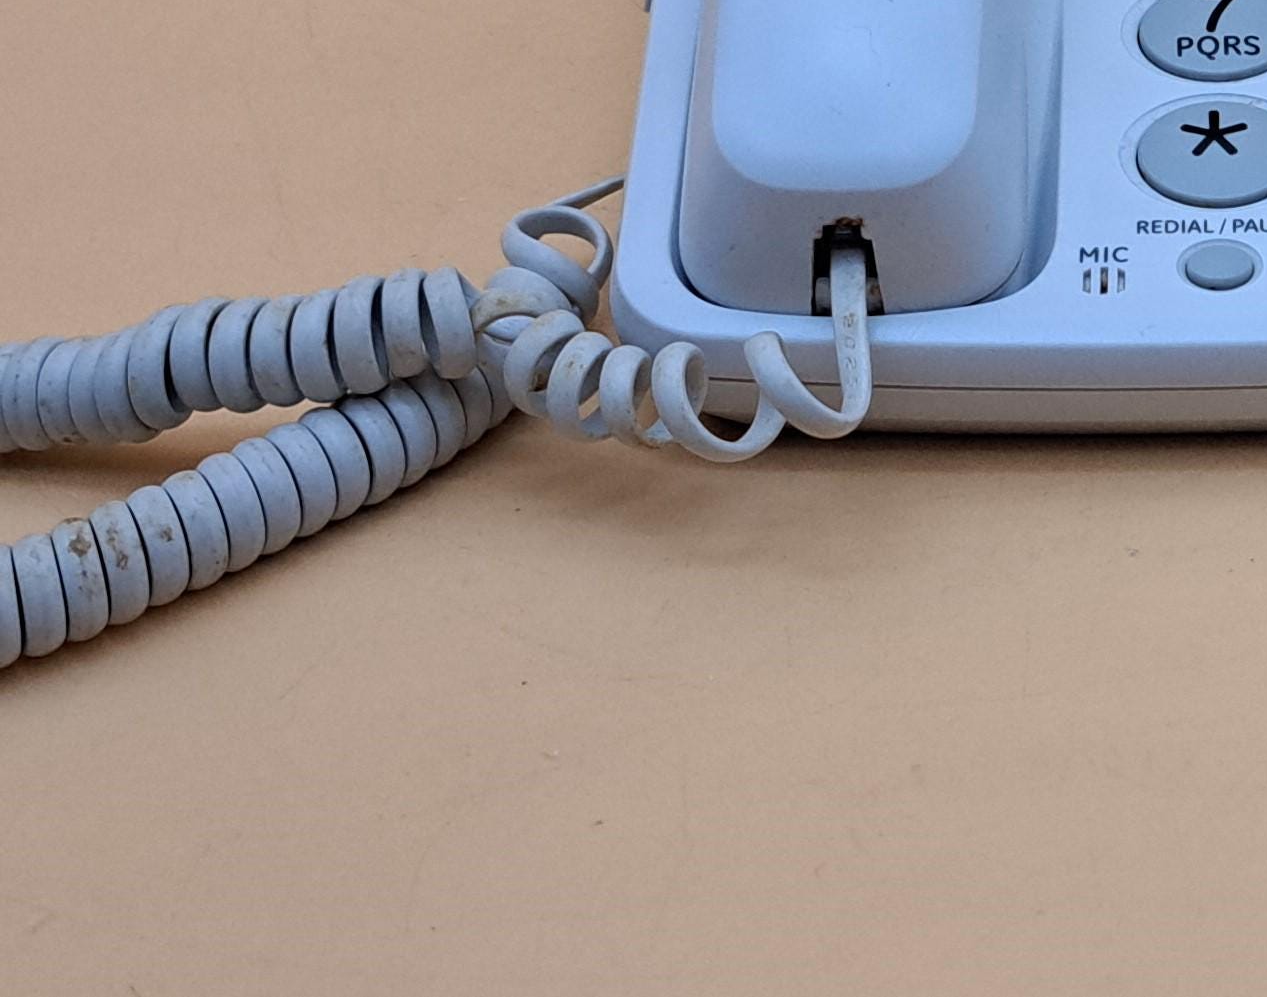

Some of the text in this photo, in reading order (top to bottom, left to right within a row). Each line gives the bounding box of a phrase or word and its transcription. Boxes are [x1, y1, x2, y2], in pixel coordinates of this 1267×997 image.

[1176, 35, 1261, 59] PQRS
[1137, 219, 1214, 235] REDIAL
[1079, 246, 1129, 264] MIC
